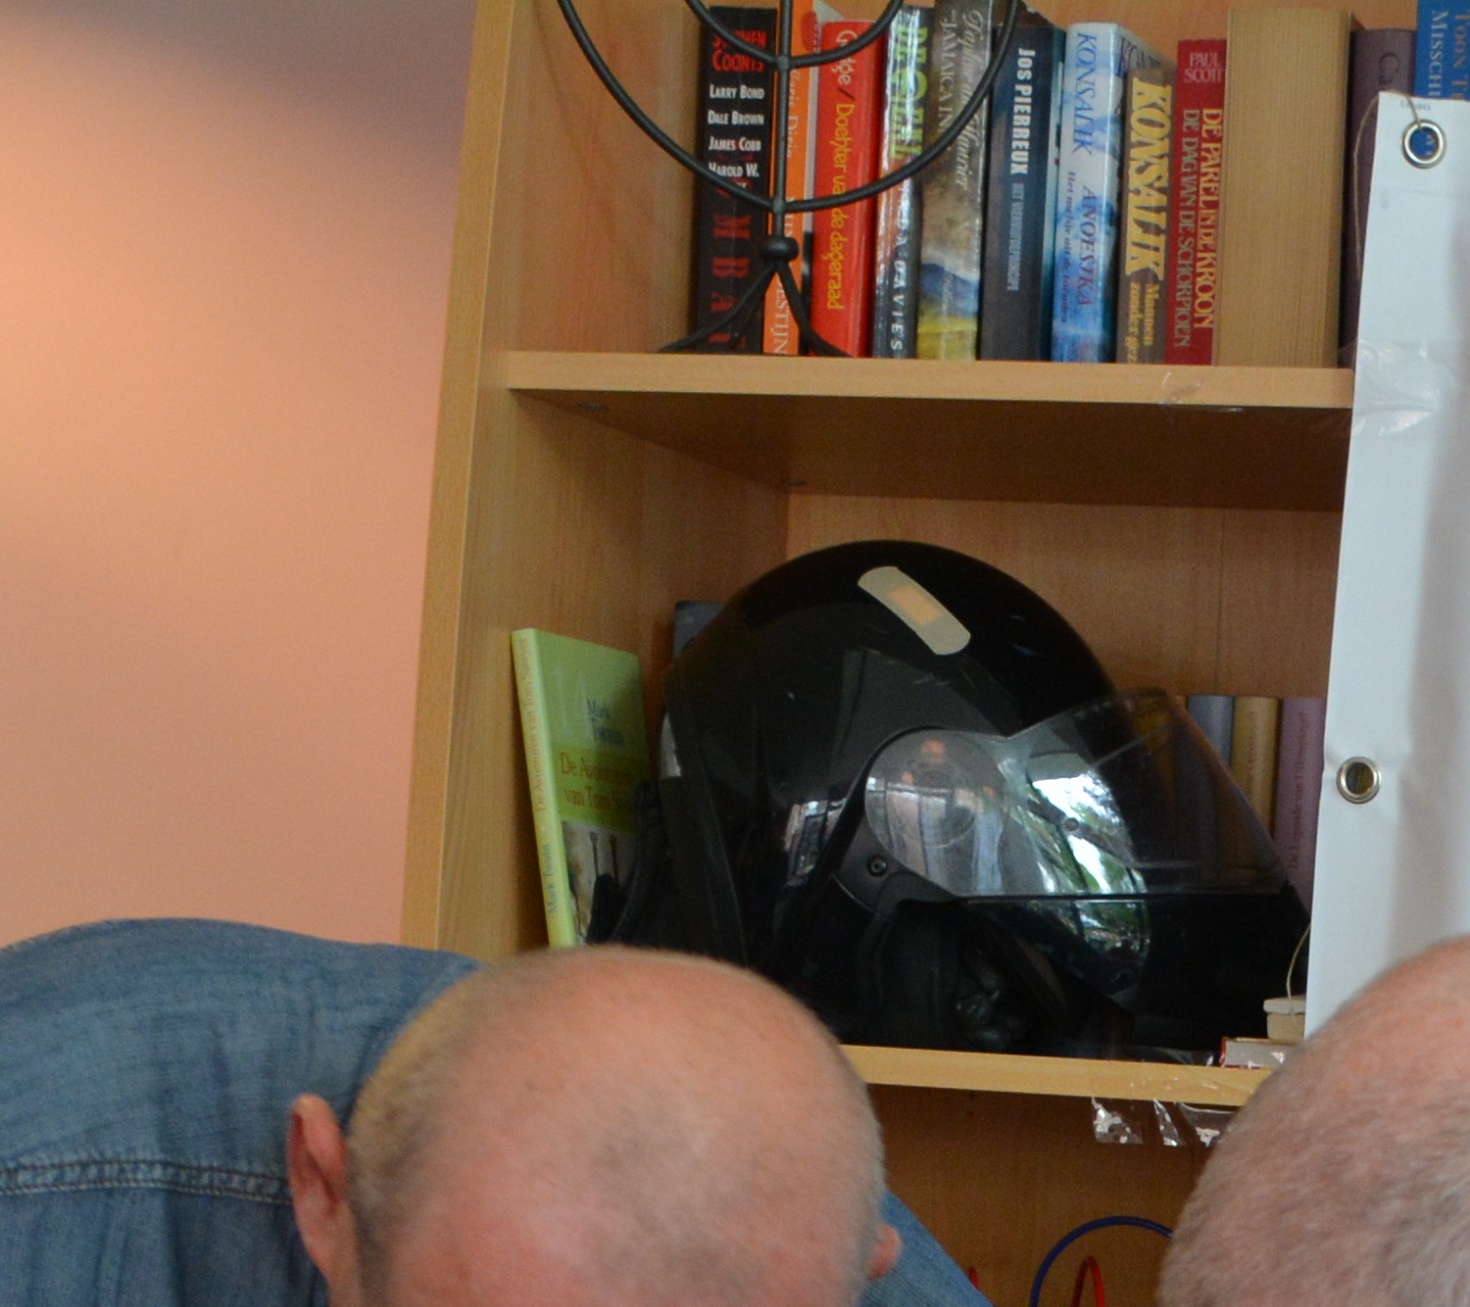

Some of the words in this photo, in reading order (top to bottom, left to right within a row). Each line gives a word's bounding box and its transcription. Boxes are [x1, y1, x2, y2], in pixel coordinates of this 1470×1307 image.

[938, 18, 957, 102] JAMAICA
[1016, 48, 1036, 80] Jos
[1189, 52, 1223, 67] PAUL
[709, 84, 737, 99] LARRY
[739, 84, 765, 100] BOND
[1071, 32, 1098, 156] KONSALIK
[707, 109, 729, 125] DALE
[732, 110, 765, 125] BROWN
[1010, 83, 1033, 175] PIERREUX
[1183, 109, 1200, 133] DE
[1201, 107, 1223, 137] DE
[708, 135, 736, 151] JAMES
[738, 136, 762, 151] COBB
[832, 103, 855, 171] Dochter
[1178, 137, 1199, 173] DAG
[1125, 78, 1172, 281] KONSALIK
[1178, 174, 1198, 207] VAN
[1198, 141, 1222, 208] PAREL
[831, 206, 848, 227] de
[1178, 210, 1196, 233] DE
[1199, 209, 1216, 226] IN
[1198, 227, 1216, 249] DE
[821, 228, 848, 310] dageraad
[1173, 236, 1195, 347] SCHORPIOEN
[1193, 250, 1217, 328] KROON
[1128, 282, 1143, 335] zonder
[559, 751, 577, 776] De
